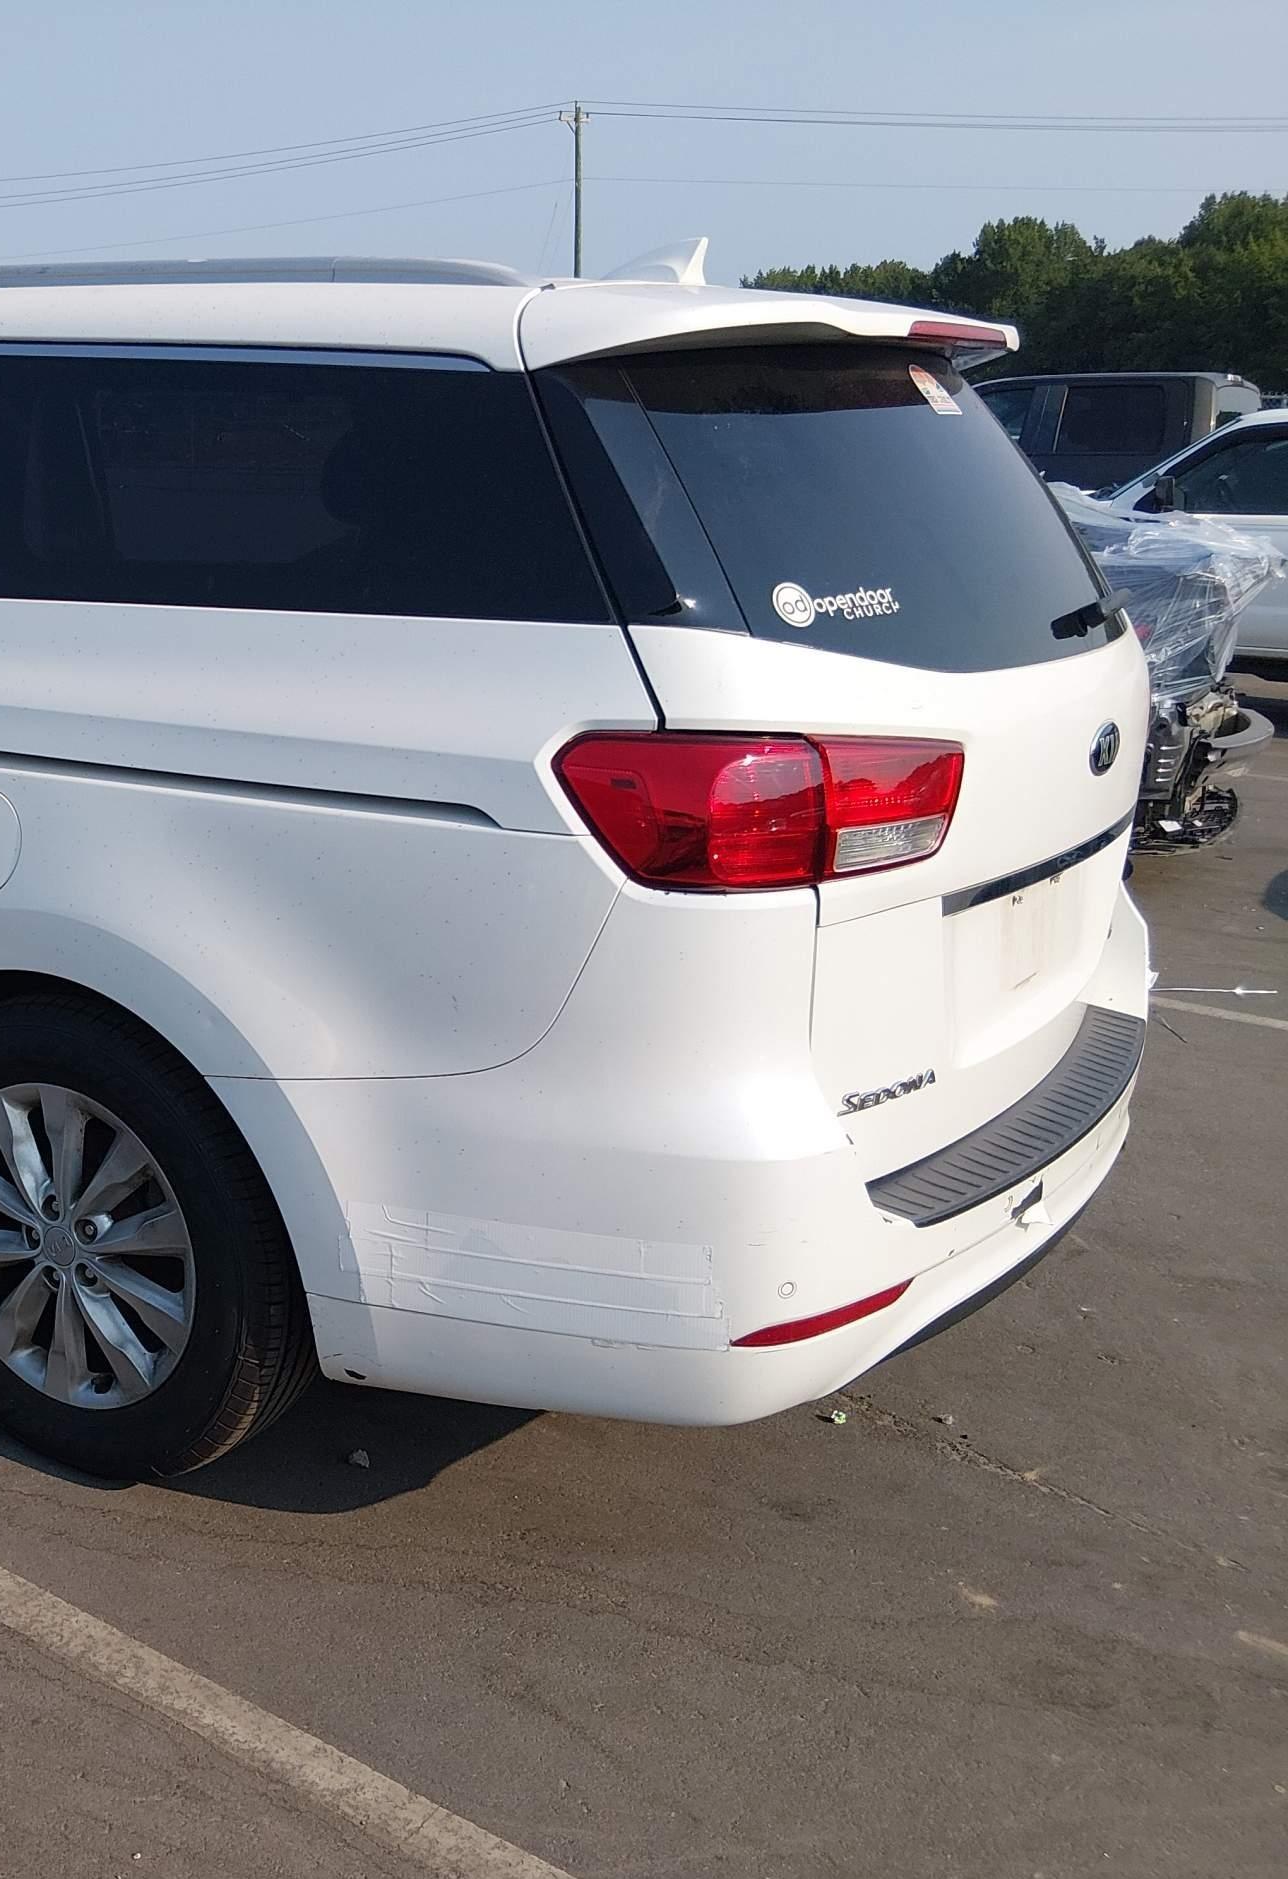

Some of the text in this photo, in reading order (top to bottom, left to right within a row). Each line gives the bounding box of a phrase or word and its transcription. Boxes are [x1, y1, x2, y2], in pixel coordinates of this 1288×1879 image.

[813, 586, 892, 616] opendoor
[843, 601, 900, 621] CHURCH
[836, 1067, 936, 1117] SEDONA
